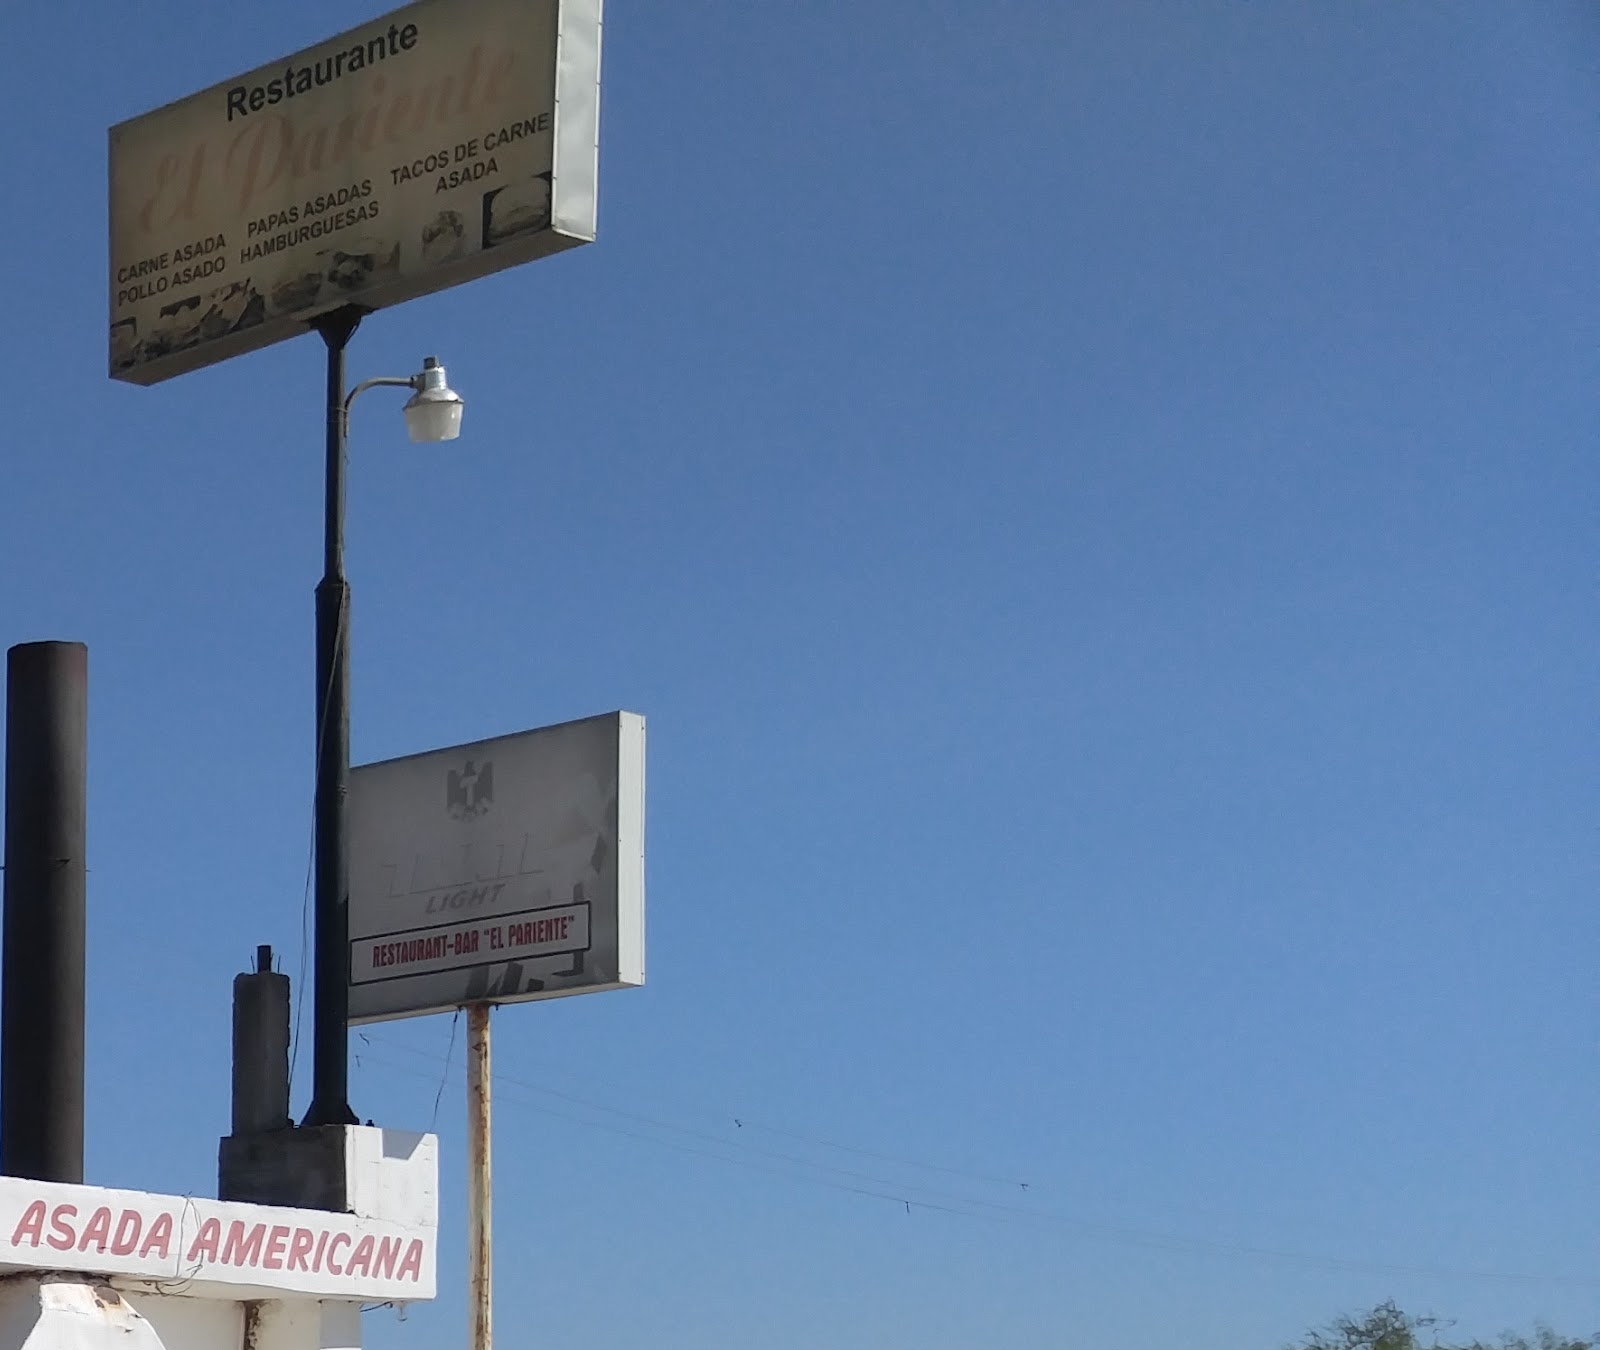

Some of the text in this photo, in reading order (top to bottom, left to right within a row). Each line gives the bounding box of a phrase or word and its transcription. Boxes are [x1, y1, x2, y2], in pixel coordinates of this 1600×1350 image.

[227, 22, 418, 121] Restaurante
[389, 113, 550, 186] TACOS DE CARNE
[435, 157, 499, 194] ASADA
[239, 200, 380, 265] HAMBURGUESAS
[247, 178, 373, 238] PAPAS ASADAS
[116, 233, 227, 285] CARNE ASADA
[117, 257, 226, 306] POLLO ASADO
[372, 928, 480, 968] RESTAURANT-BAR
[10, 1199, 174, 1260] ASADA
[187, 1217, 423, 1284] AMERICANA
